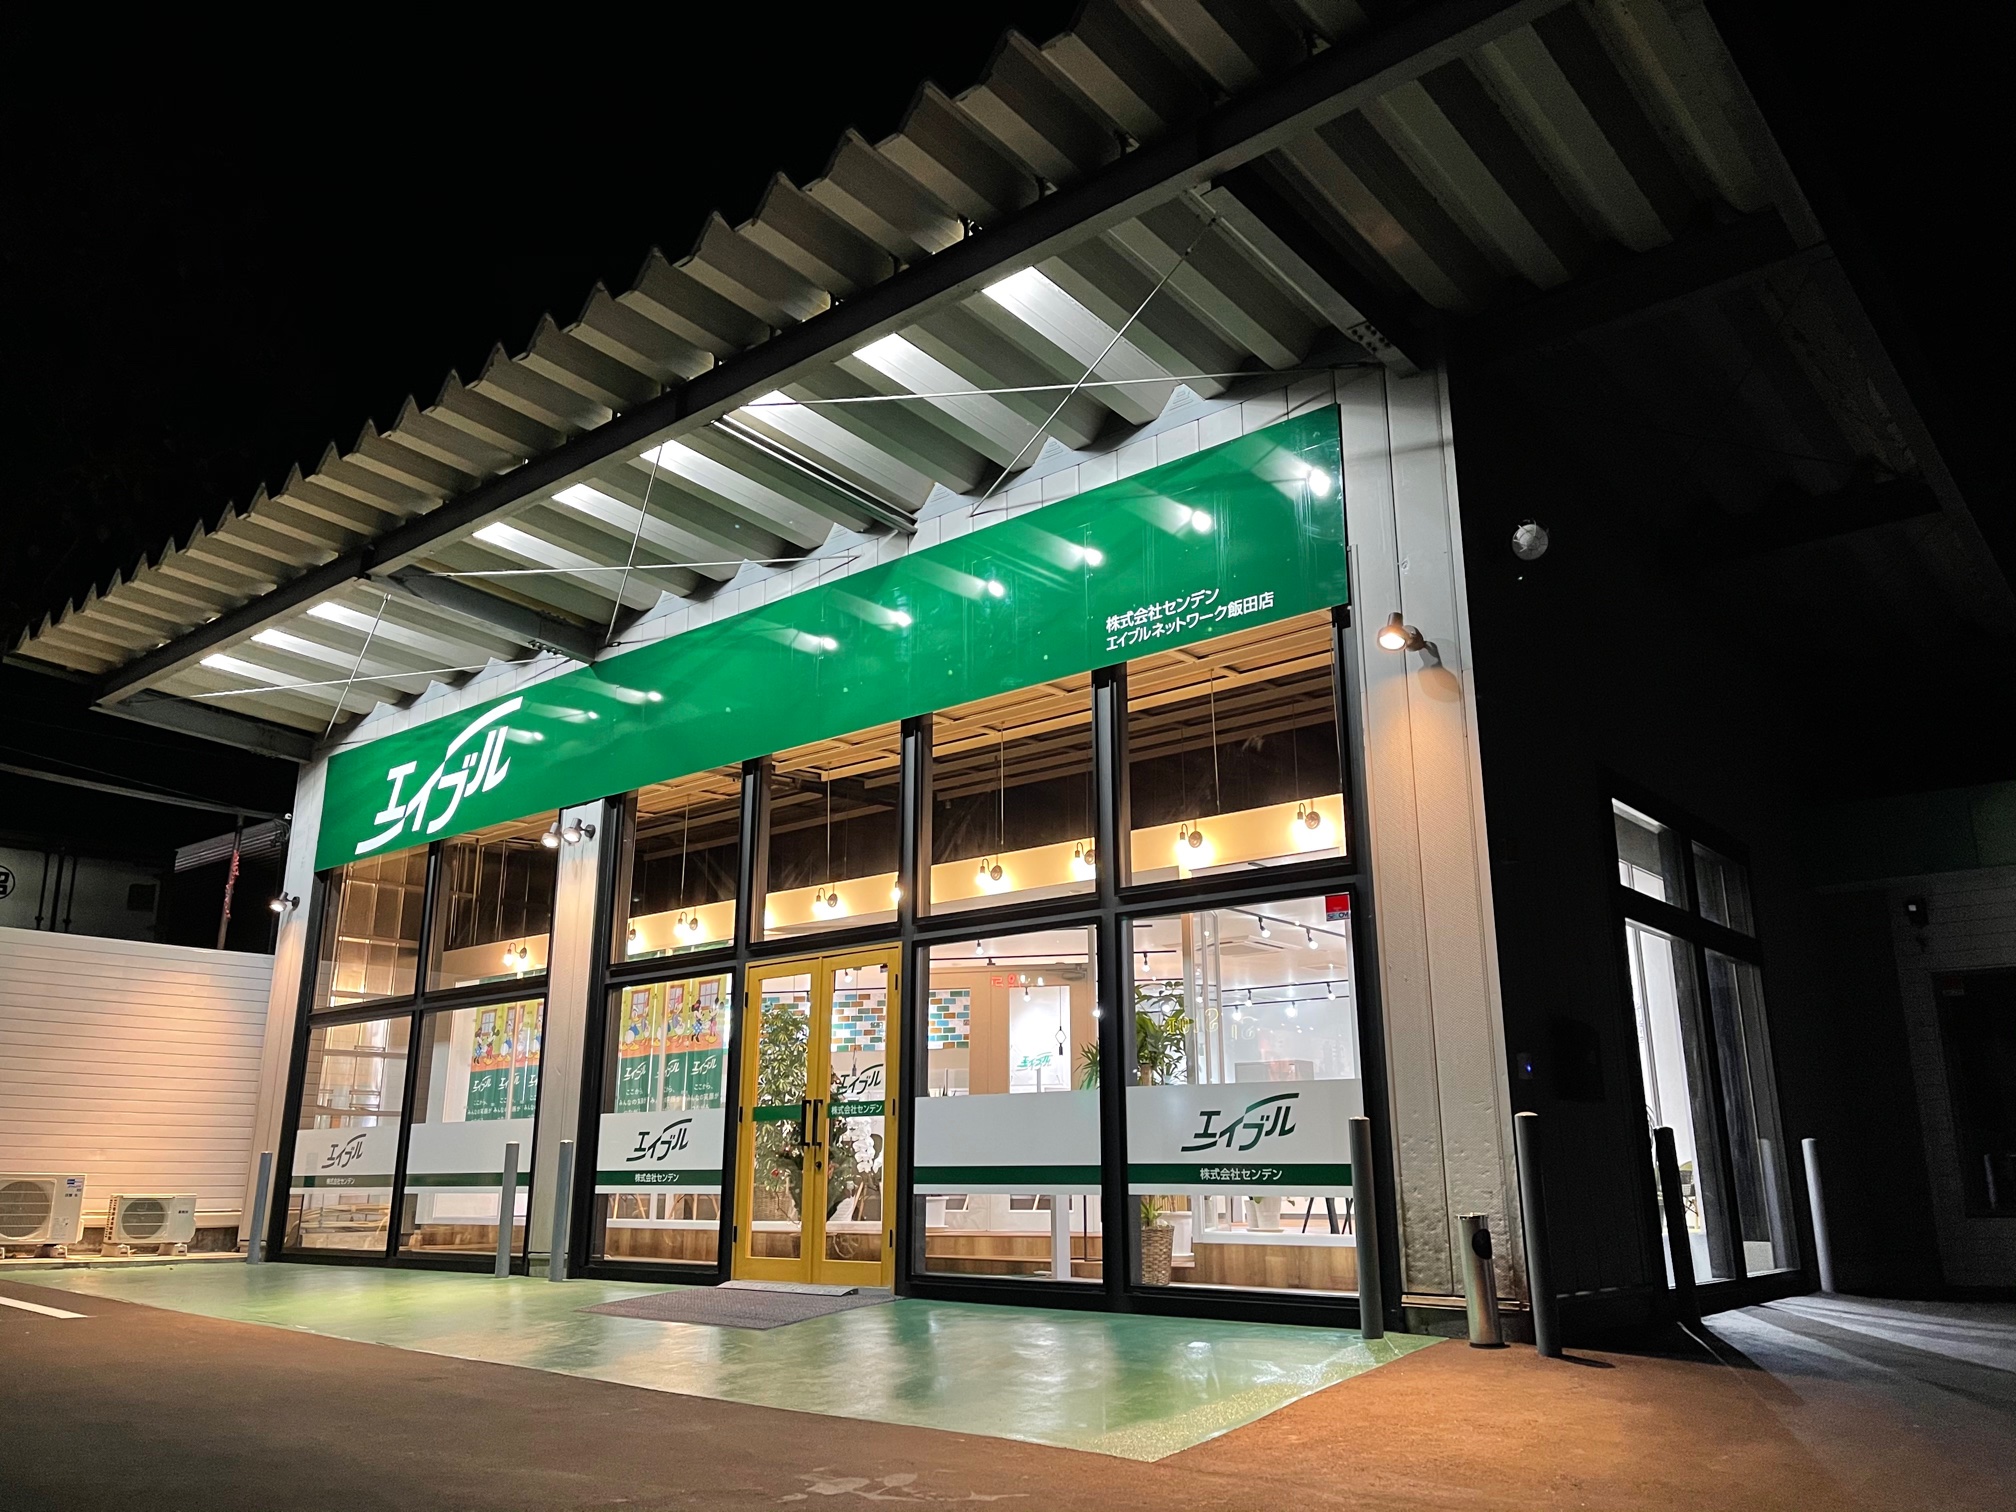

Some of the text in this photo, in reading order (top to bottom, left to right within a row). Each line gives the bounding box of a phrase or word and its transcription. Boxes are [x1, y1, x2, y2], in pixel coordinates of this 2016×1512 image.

[1106, 588, 1219, 633] 株式会社センデン
[1106, 591, 1274, 651] エイブルネットワーク飯田店
[354, 696, 524, 855] エイブル
[690, 1055, 718, 1076] エイブル
[837, 1064, 884, 1095] エイブル
[831, 1103, 883, 1115] 株式会社センデン
[1181, 1092, 1300, 1152] エイブル
[321, 1133, 367, 1169] エイブル
[626, 1118, 693, 1162] エイブル
[634, 1172, 680, 1183] 株式会社センデン
[1199, 1167, 1284, 1181] 株式会社センデン
